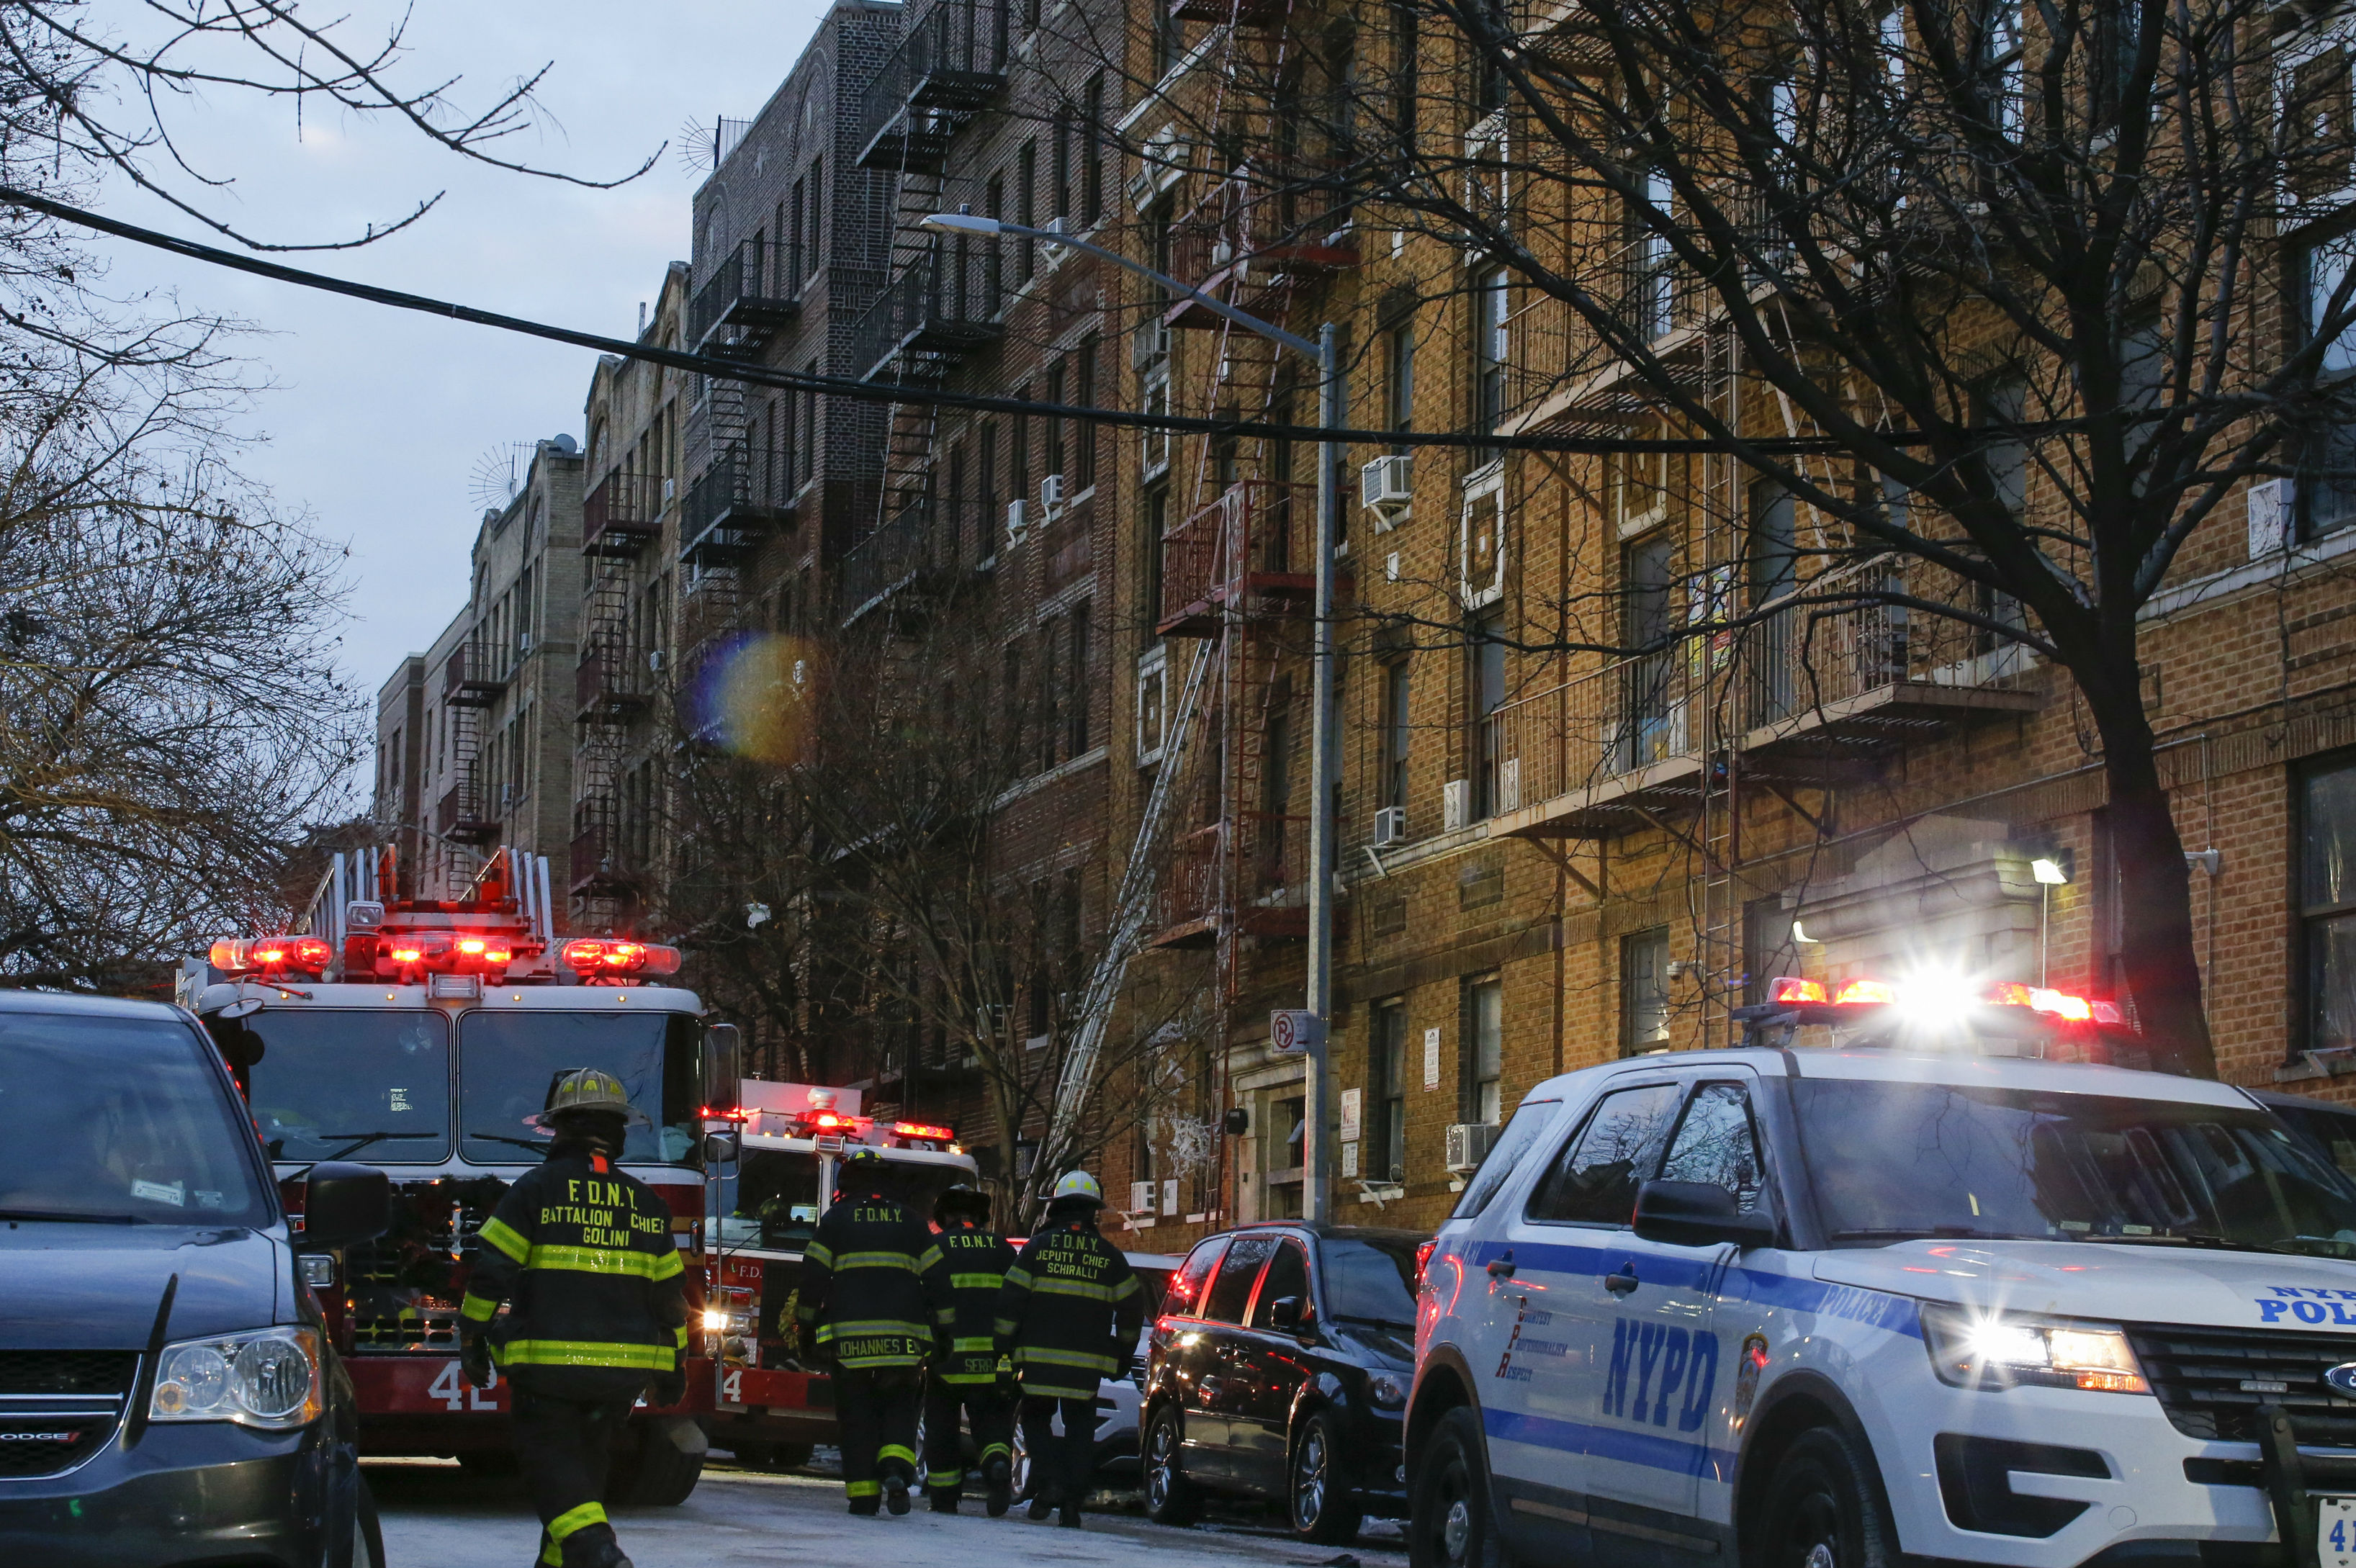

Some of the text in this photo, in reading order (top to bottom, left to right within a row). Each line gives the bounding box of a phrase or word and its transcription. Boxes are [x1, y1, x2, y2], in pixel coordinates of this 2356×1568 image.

[541, 1206, 665, 1234] BATTALION CHIEF
[854, 1207, 902, 1222] F.D.N.Y.
[583, 1227, 630, 1247] GOLINI
[948, 1235, 997, 1249] F.D.N.Y.
[1047, 1262, 1097, 1279] SCHIRALLI
[1082, 1254, 1110, 1269] CHIEF
[1817, 1284, 1892, 1327] POLICE
[837, 1338, 900, 1357] JOHANNES
[964, 1358, 997, 1373] SERR
[1603, 1317, 1719, 1433] NYPD
[2329, 1519, 2356, 1552] 4
